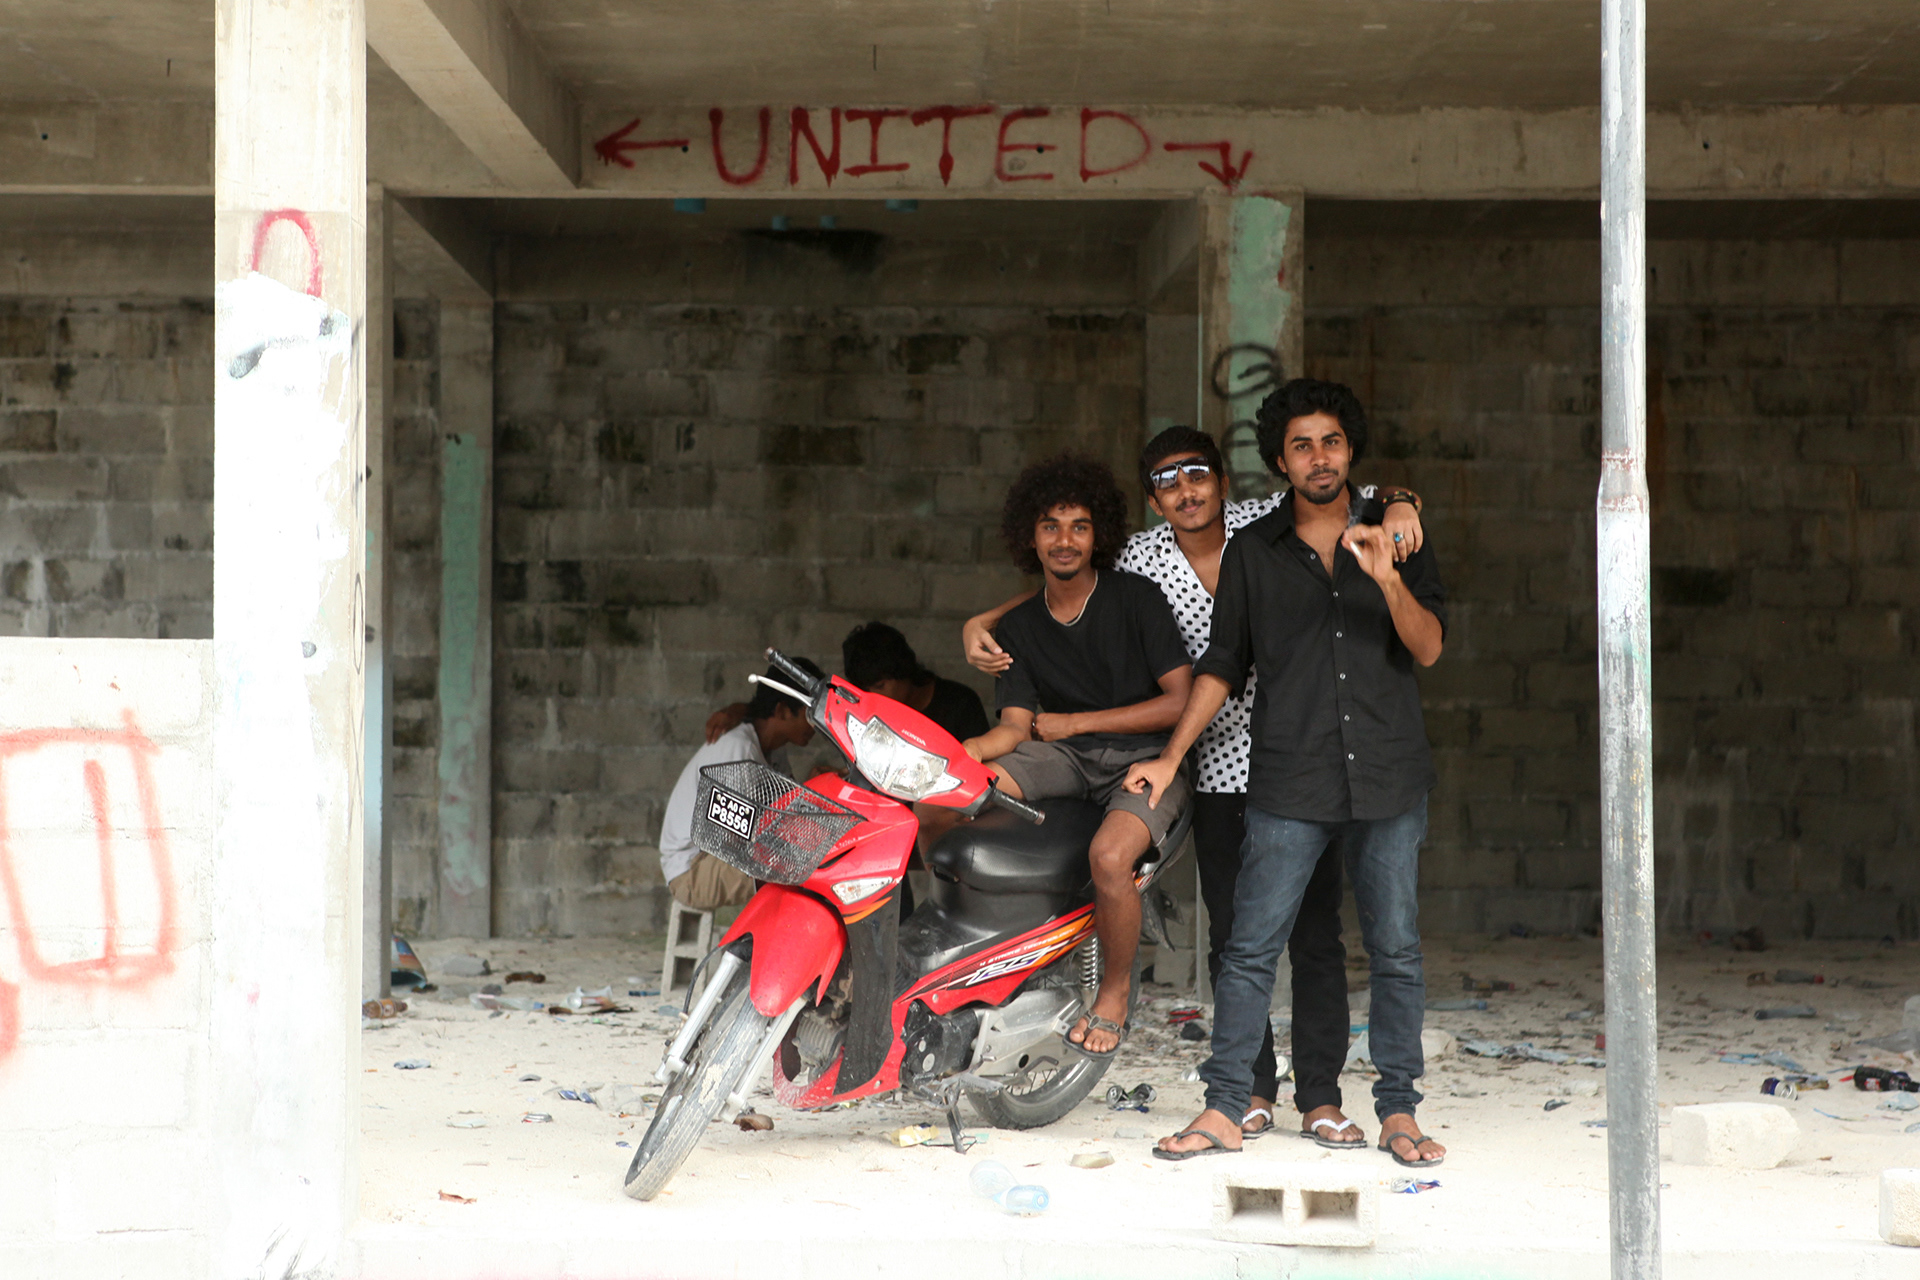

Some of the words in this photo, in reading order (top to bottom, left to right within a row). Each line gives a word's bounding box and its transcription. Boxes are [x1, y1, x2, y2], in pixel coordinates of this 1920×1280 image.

[708, 104, 1152, 188] UNITED
[901, 729, 926, 746] HONDA
[711, 802, 749, 834] P8556
[987, 946, 1022, 964] STROKE
[1023, 926, 1077, 951] TECHNOLOGY
